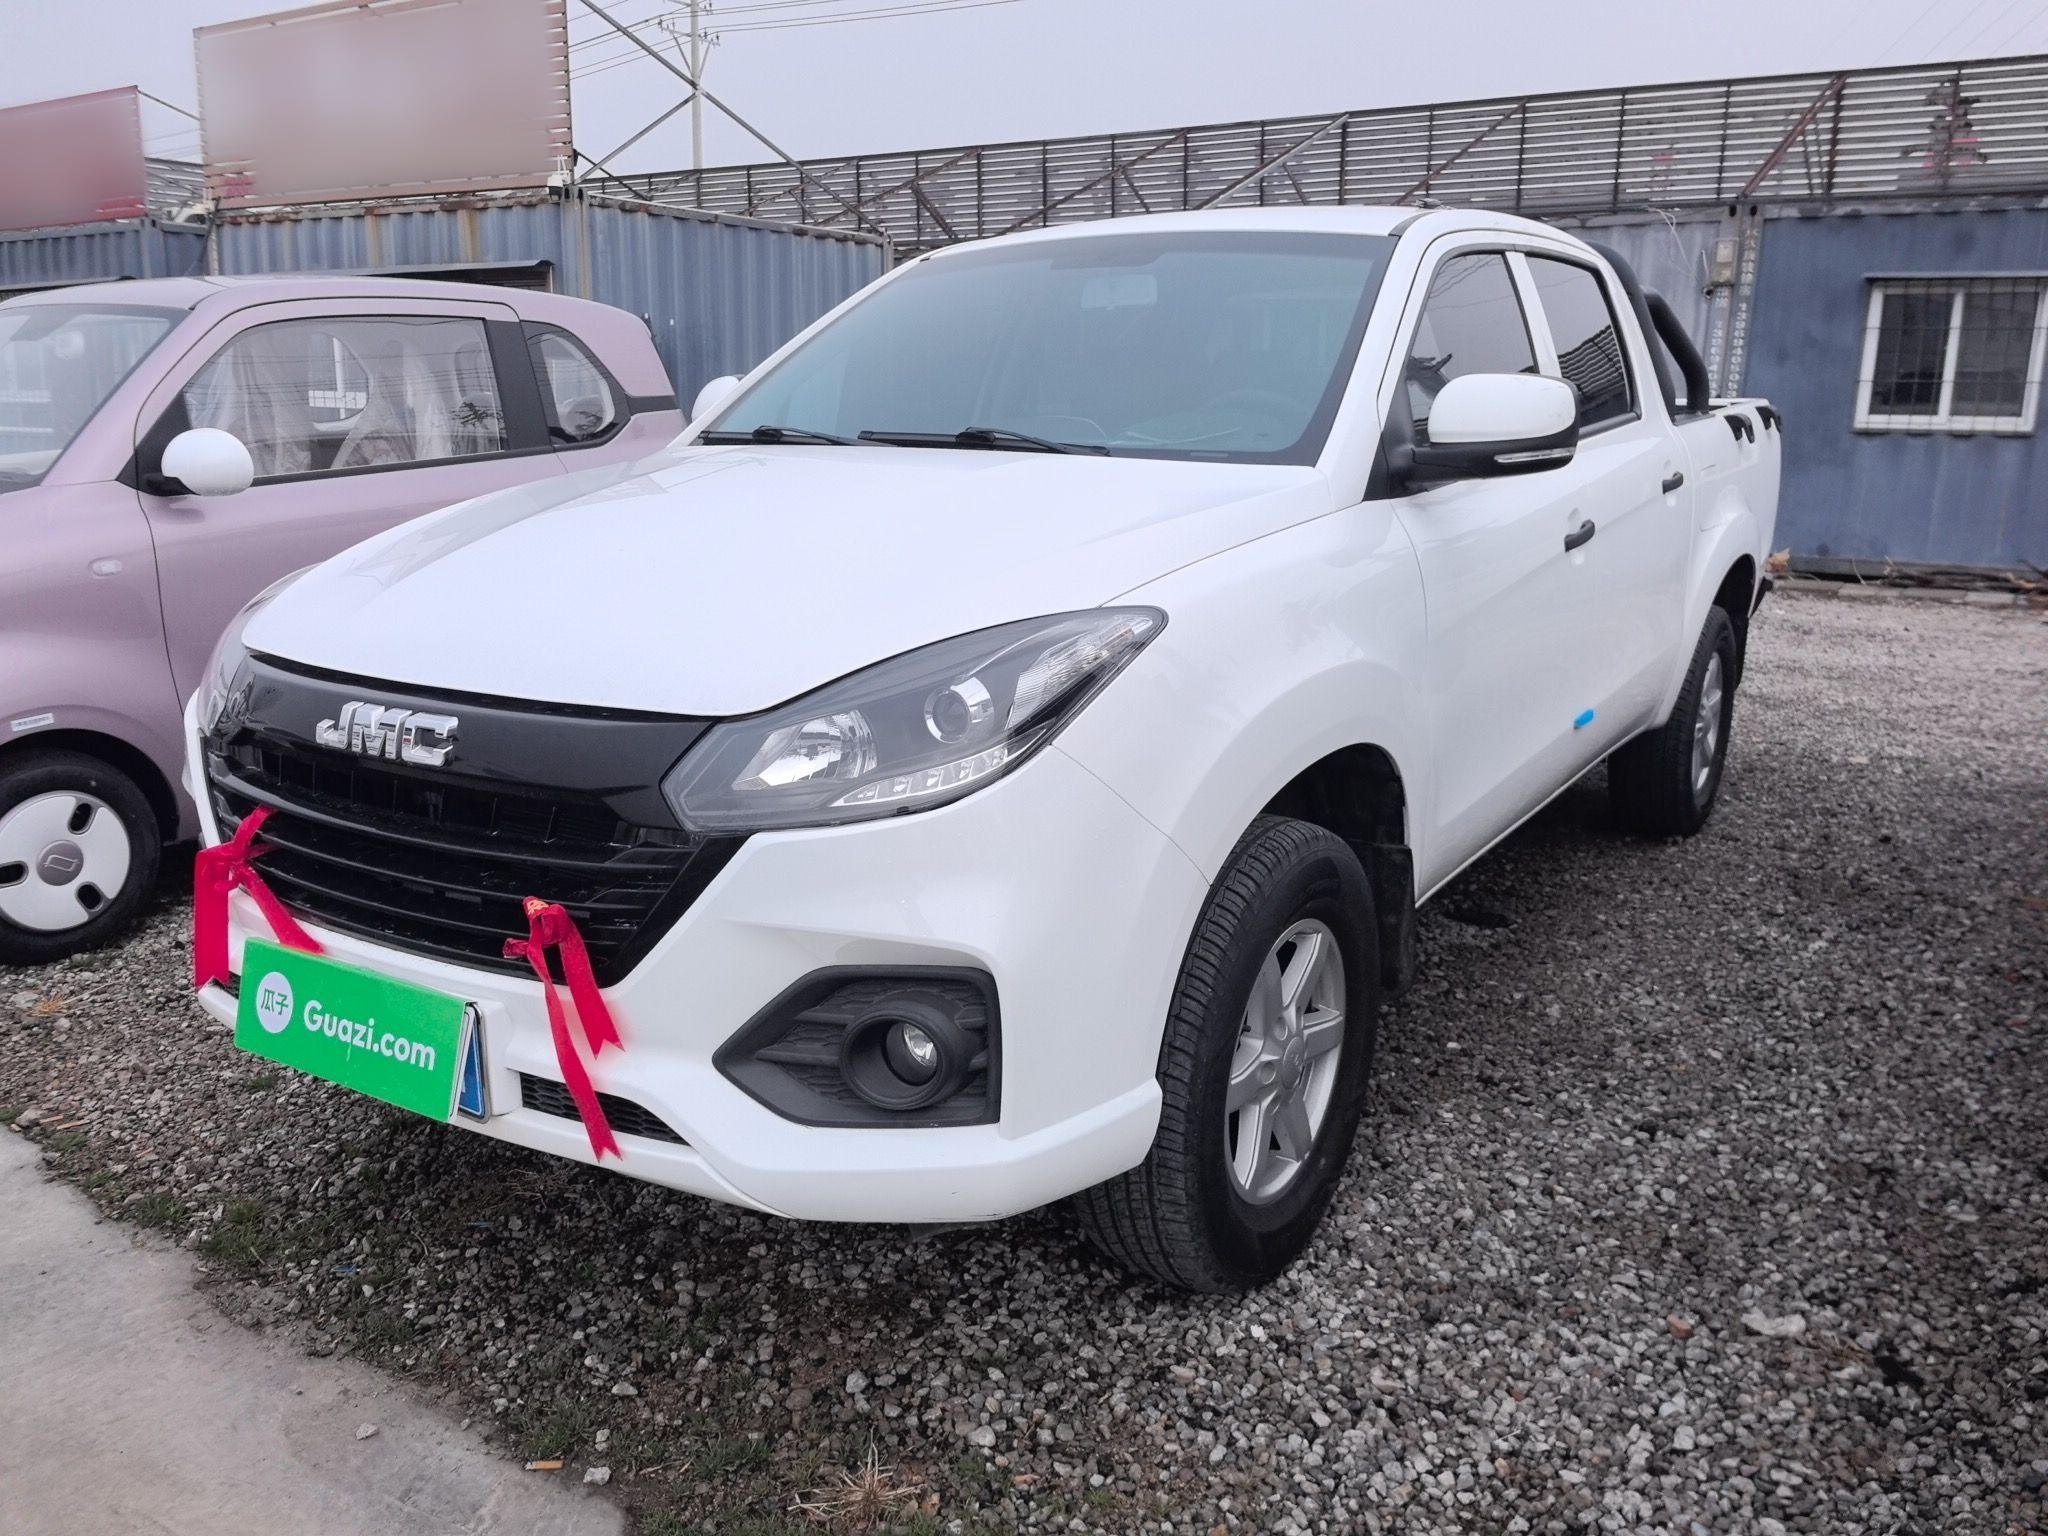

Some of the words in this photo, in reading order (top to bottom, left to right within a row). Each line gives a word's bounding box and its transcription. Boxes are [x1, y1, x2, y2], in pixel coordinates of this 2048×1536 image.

[315, 701, 459, 767] JMC
[260, 988, 289, 1016] 瓜子
[303, 999, 436, 1071] Guazi.com
